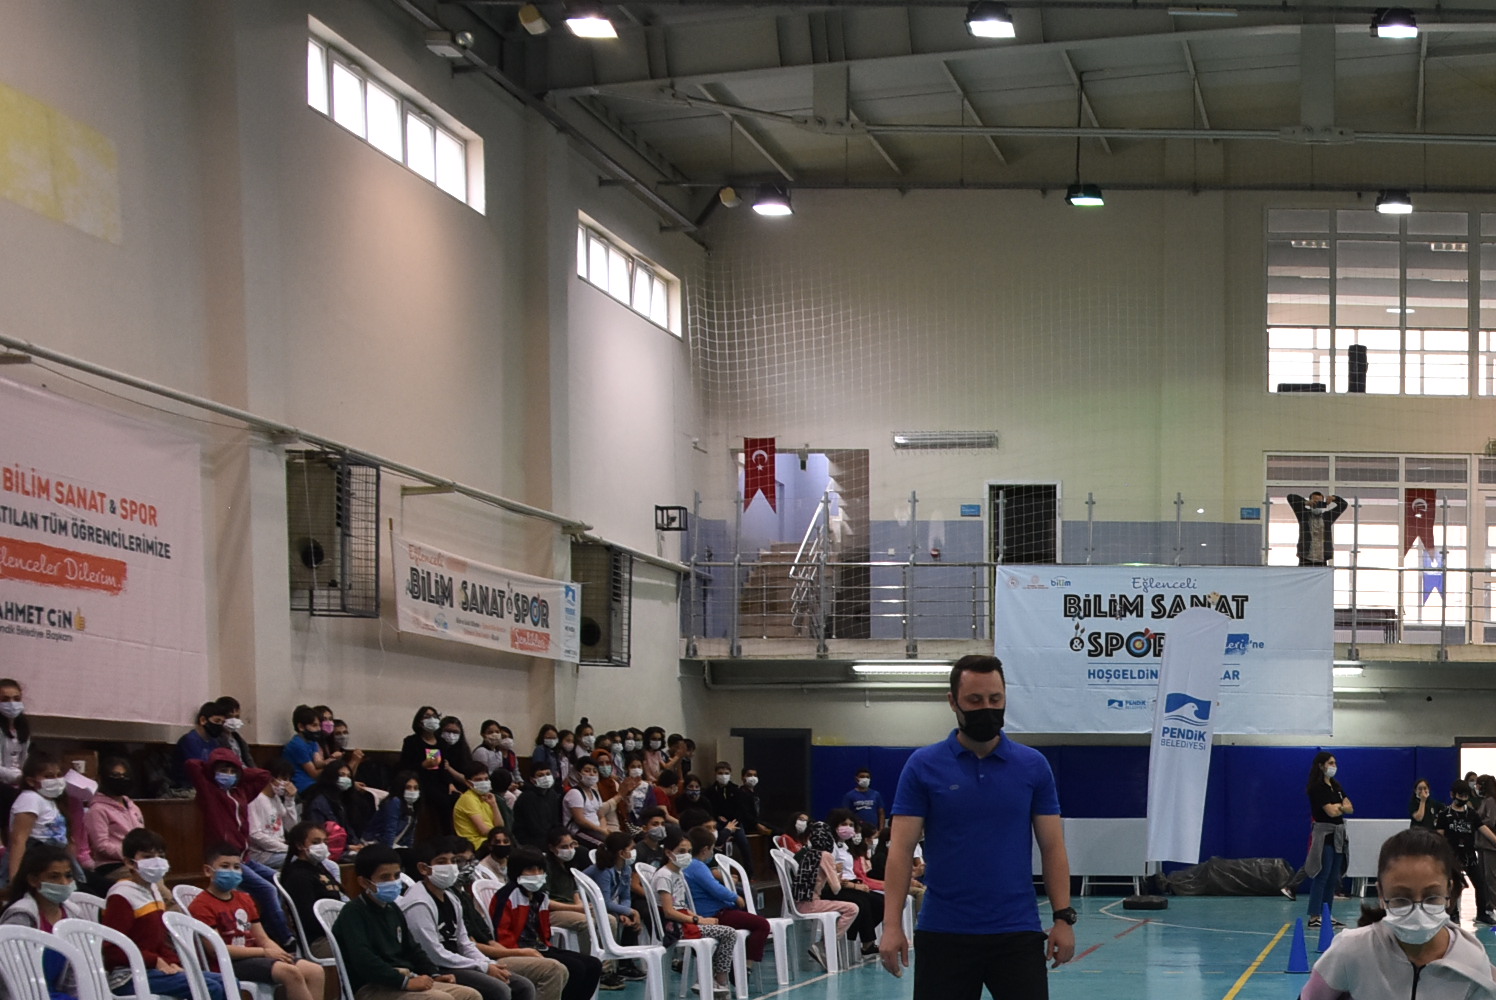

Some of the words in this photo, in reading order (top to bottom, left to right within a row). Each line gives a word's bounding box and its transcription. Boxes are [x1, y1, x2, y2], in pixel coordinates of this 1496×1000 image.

[55, 481, 106, 514] SANAT
[110, 499, 116, 514] &
[120, 498, 158, 527] SPOR
[0, 505, 38, 530] TILAN
[41, 513, 68, 536] TÜM
[0, 546, 61, 576] lenceler
[1132, 577, 1197, 591] Eğlenceli
[460, 580, 506, 619] SANAT
[514, 592, 550, 629] SPOR
